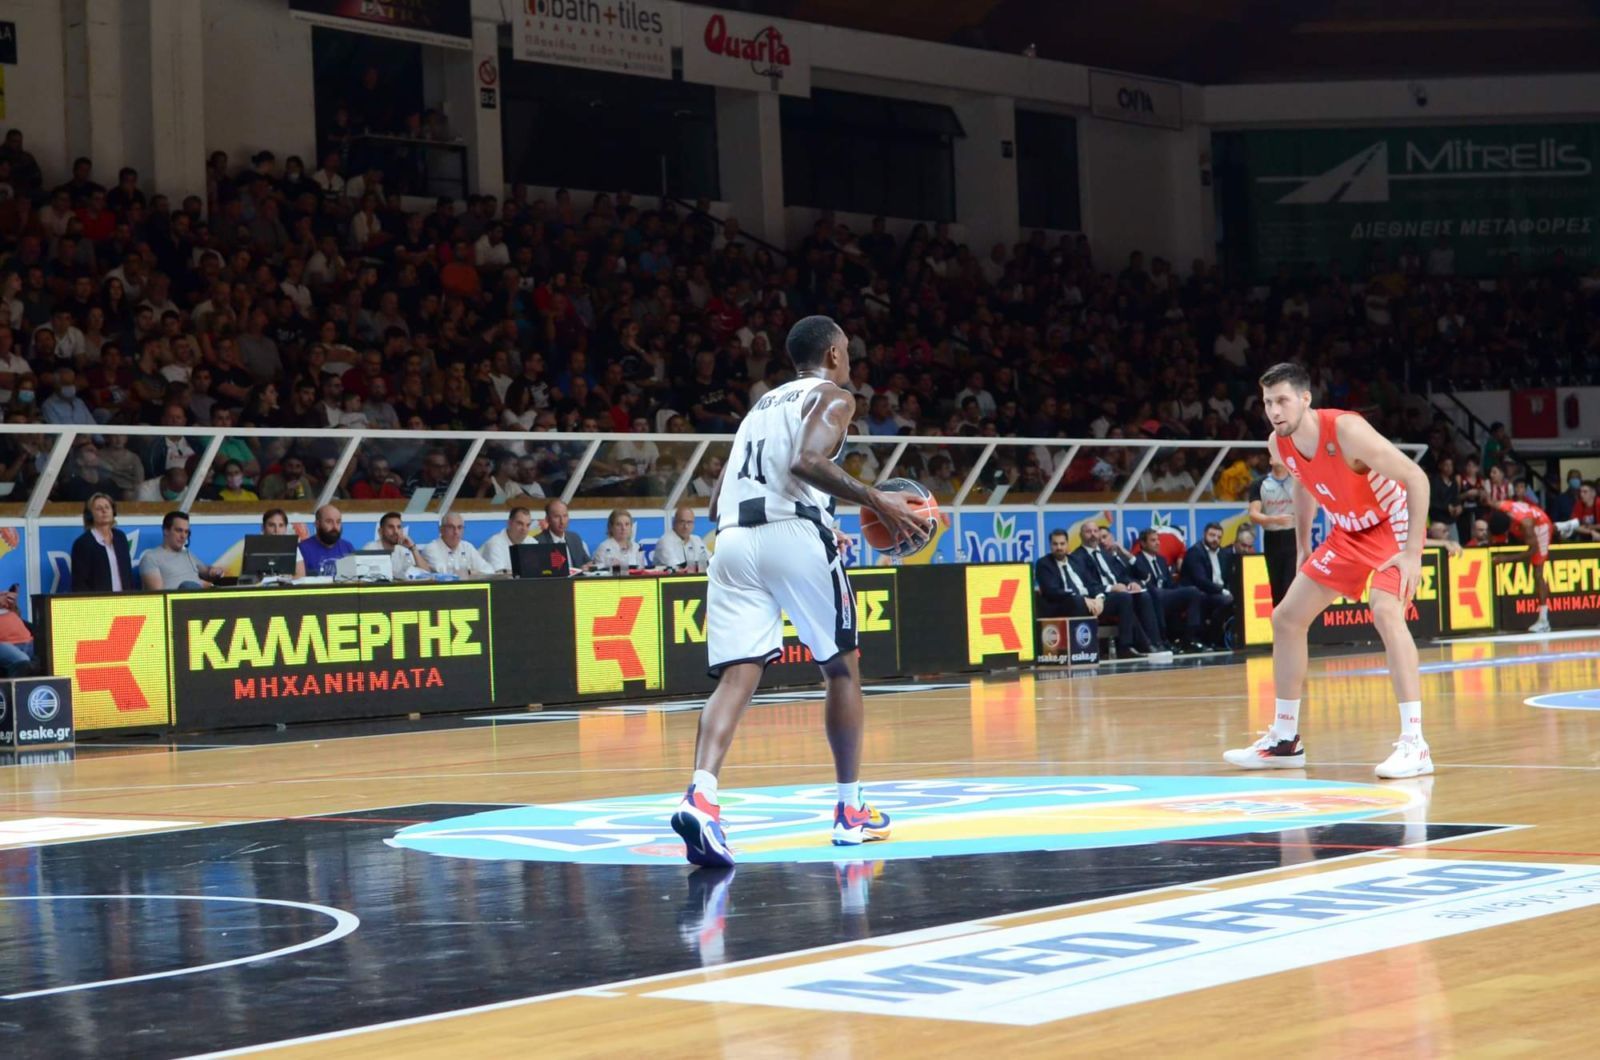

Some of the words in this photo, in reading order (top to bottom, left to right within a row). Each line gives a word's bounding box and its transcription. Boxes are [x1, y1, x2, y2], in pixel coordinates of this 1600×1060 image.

[1350, 220, 1455, 240] ΔΙΕΘΝΕΙΣ
[1460, 217, 1593, 237] ΜΕΤΑΦΟΡΕΣ
[737, 438, 767, 485] 11
[187, 608, 482, 671] ΚΑΛΛΕΡΓΗΣ
[234, 667, 444, 700] ΜΗΧΑΝΗΜΑΤΑ
[19, 725, 71, 741] esake.gr
